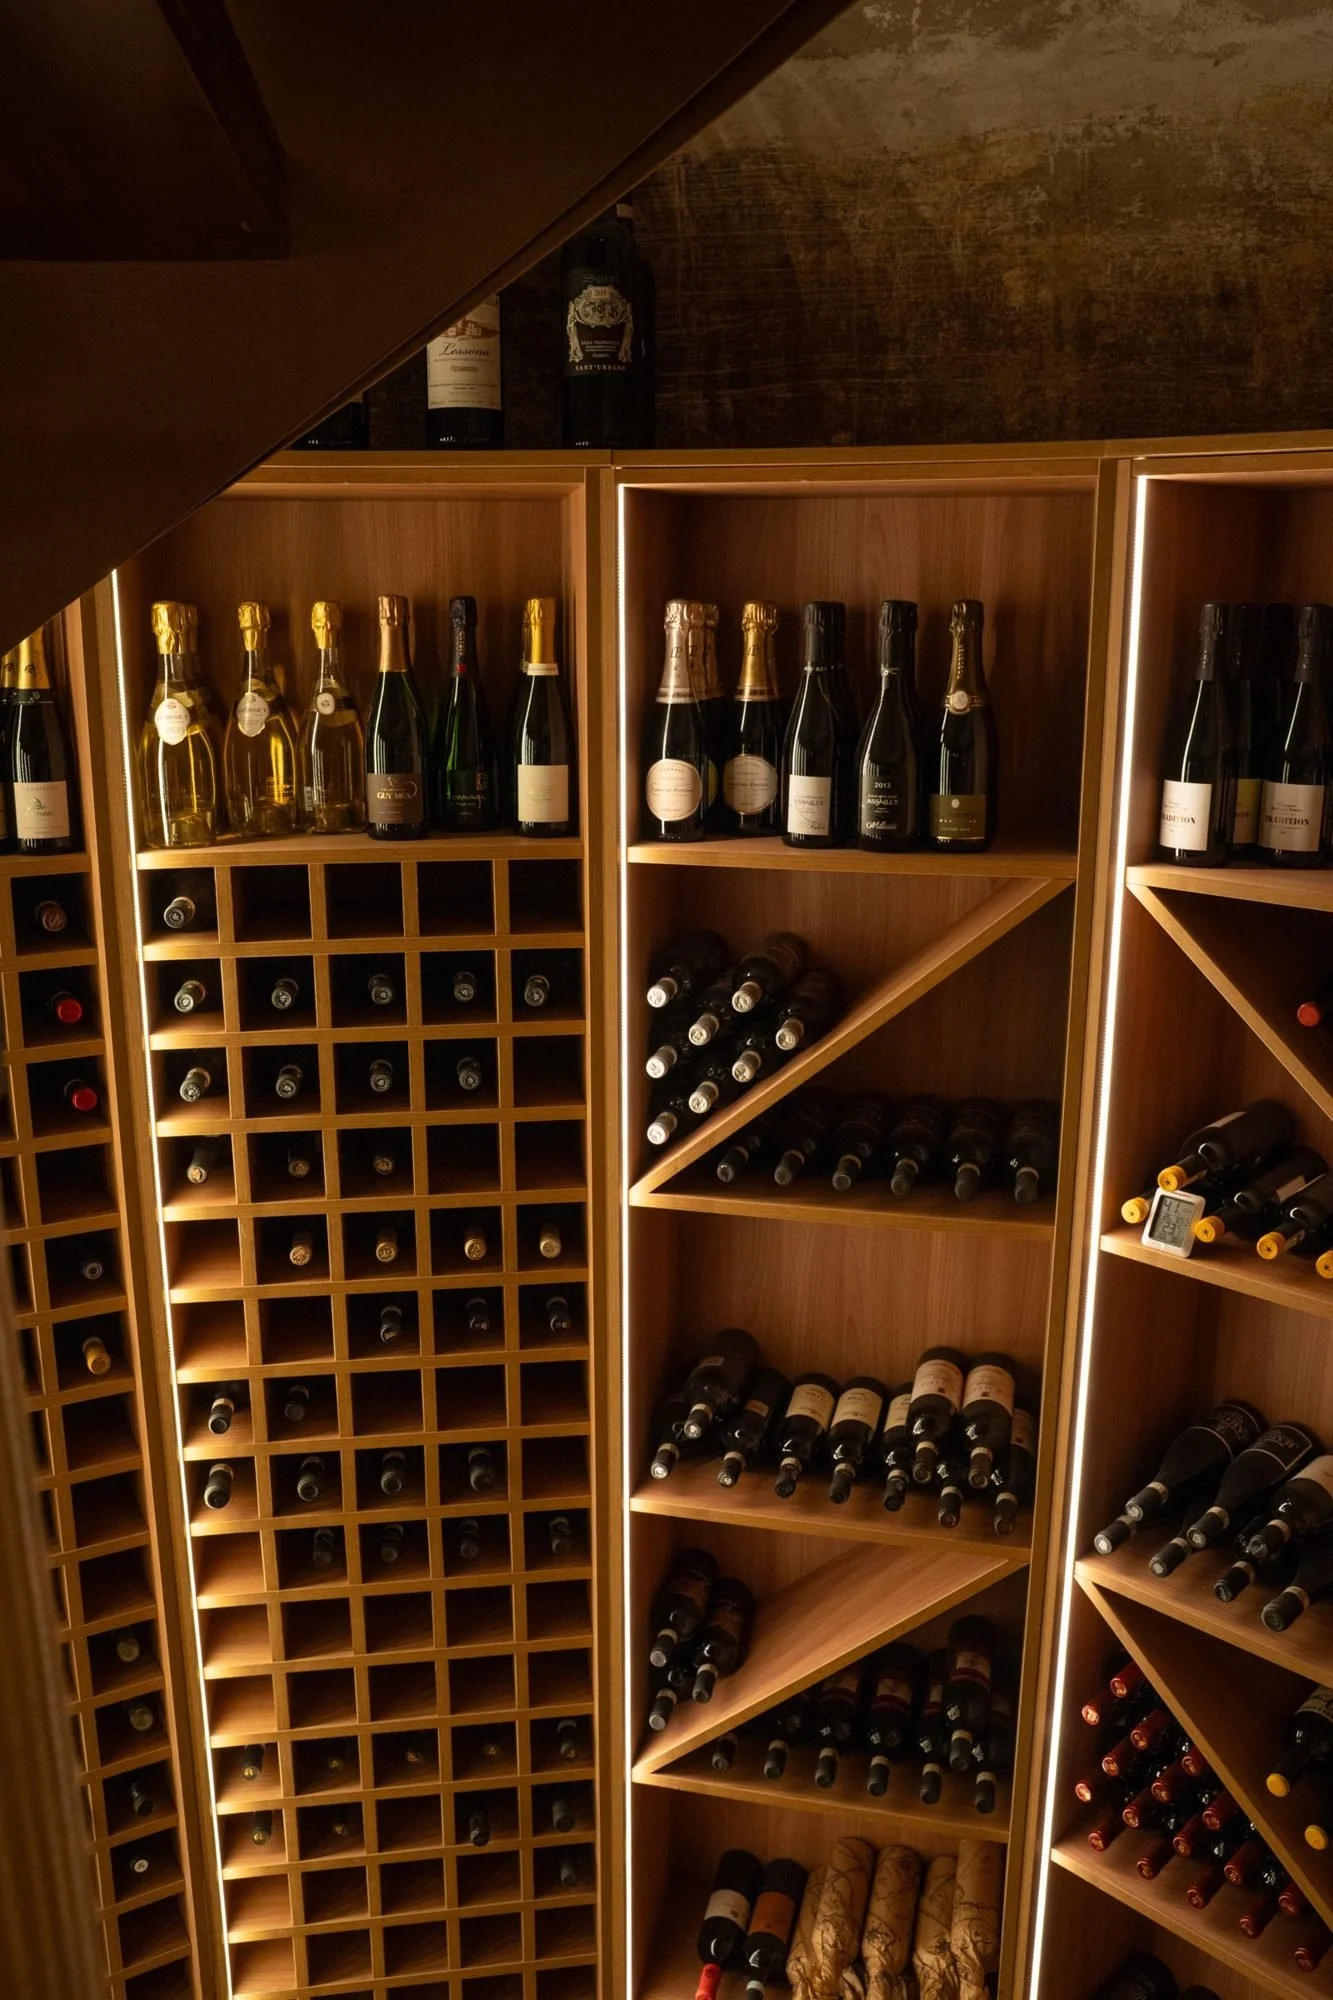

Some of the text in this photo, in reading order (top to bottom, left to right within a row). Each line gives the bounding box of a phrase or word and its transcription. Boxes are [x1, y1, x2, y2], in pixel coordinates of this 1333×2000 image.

[438, 342, 490, 357] Lessona
[376, 791, 392, 799] GUY
[1161, 813, 1197, 824] RADITION
[1264, 815, 1310, 825] TRADITION
